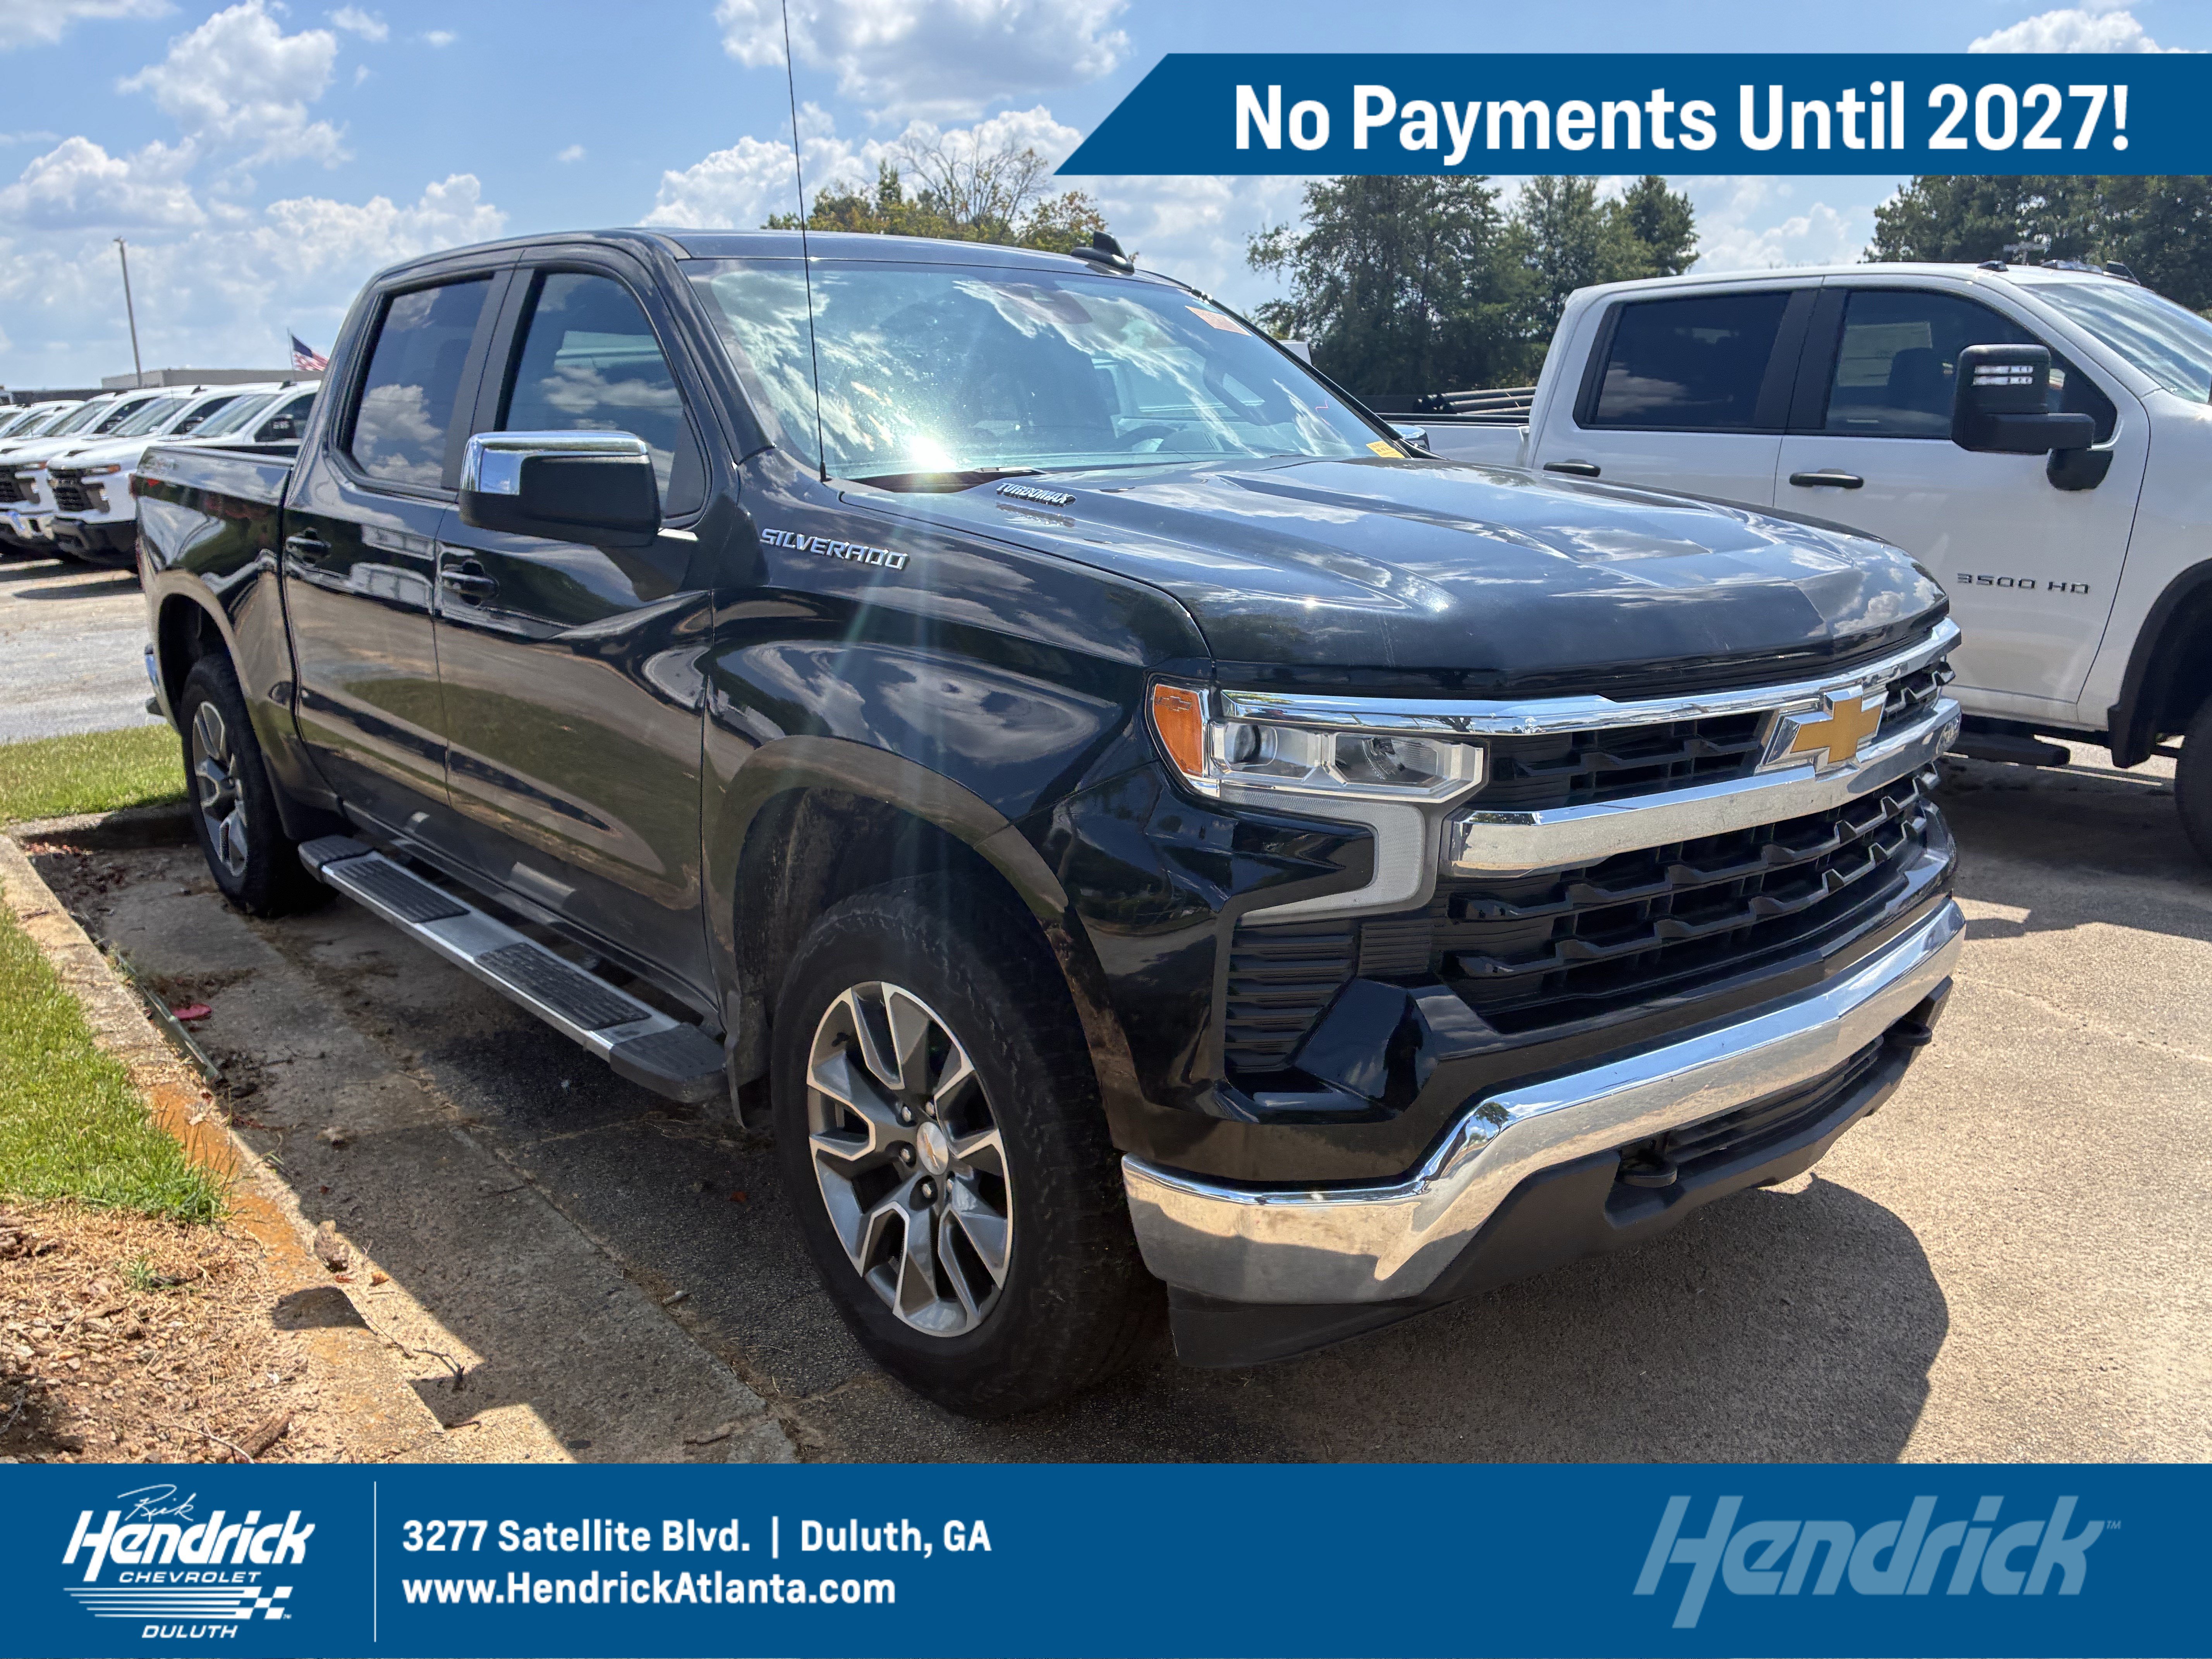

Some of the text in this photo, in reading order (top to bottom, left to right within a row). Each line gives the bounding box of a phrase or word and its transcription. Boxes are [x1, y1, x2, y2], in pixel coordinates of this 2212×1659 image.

[996, 482, 1075, 507] TURBOMAX
[760, 528, 910, 570] SILVERADO
[1957, 573, 2090, 594] 3500 HD
